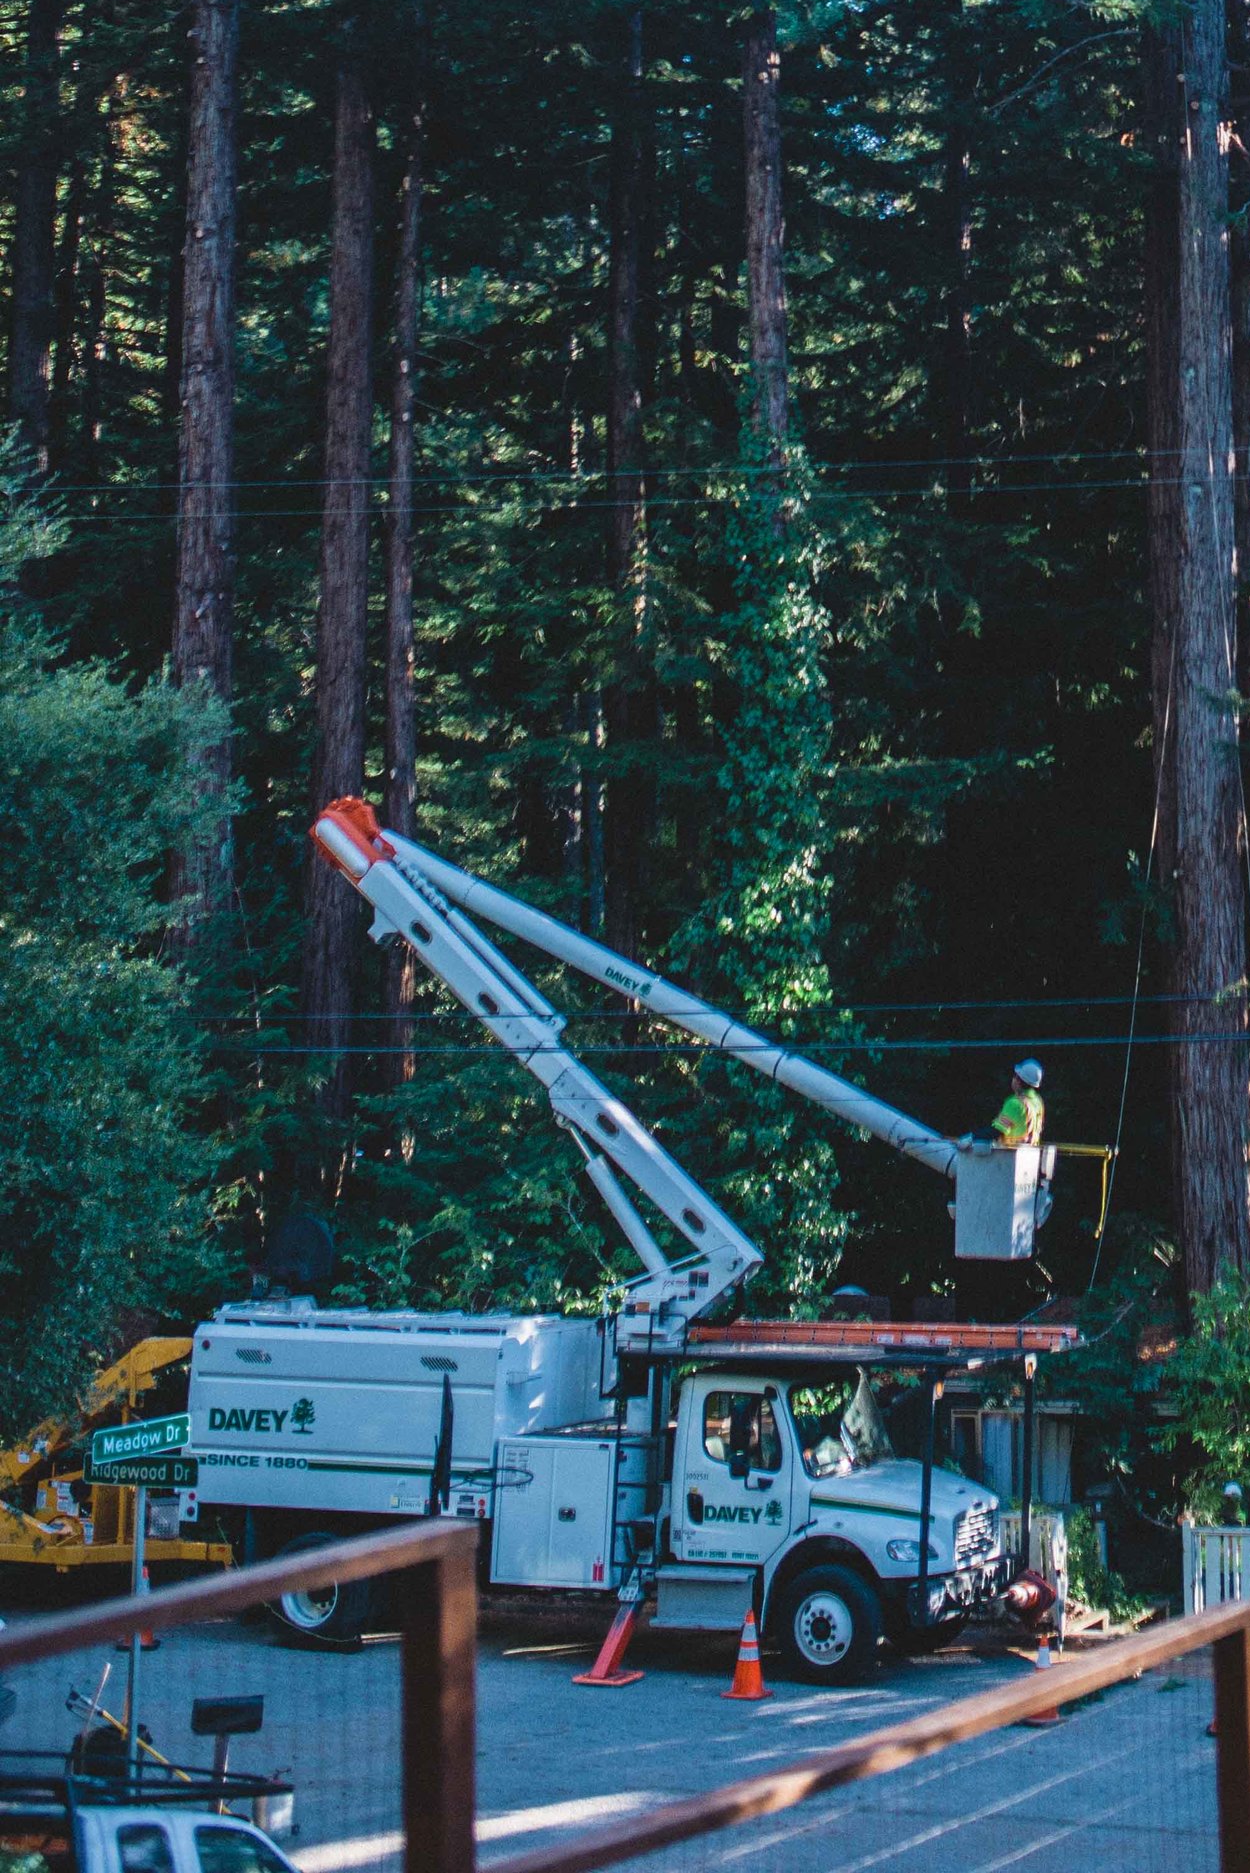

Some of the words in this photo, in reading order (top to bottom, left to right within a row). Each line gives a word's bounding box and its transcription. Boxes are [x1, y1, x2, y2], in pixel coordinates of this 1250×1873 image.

[604, 966, 640, 991] DAVEY
[208, 1408, 289, 1432] DAVEY
[103, 1427, 161, 1455] Meadow
[166, 1424, 181, 1443] Dr
[91, 1462, 167, 1484] Ridgewood
[174, 1460, 190, 1481] Dr
[206, 1454, 260, 1467] SINCE
[264, 1456, 308, 1469] 1880
[704, 1505, 762, 1524] DAVEY
